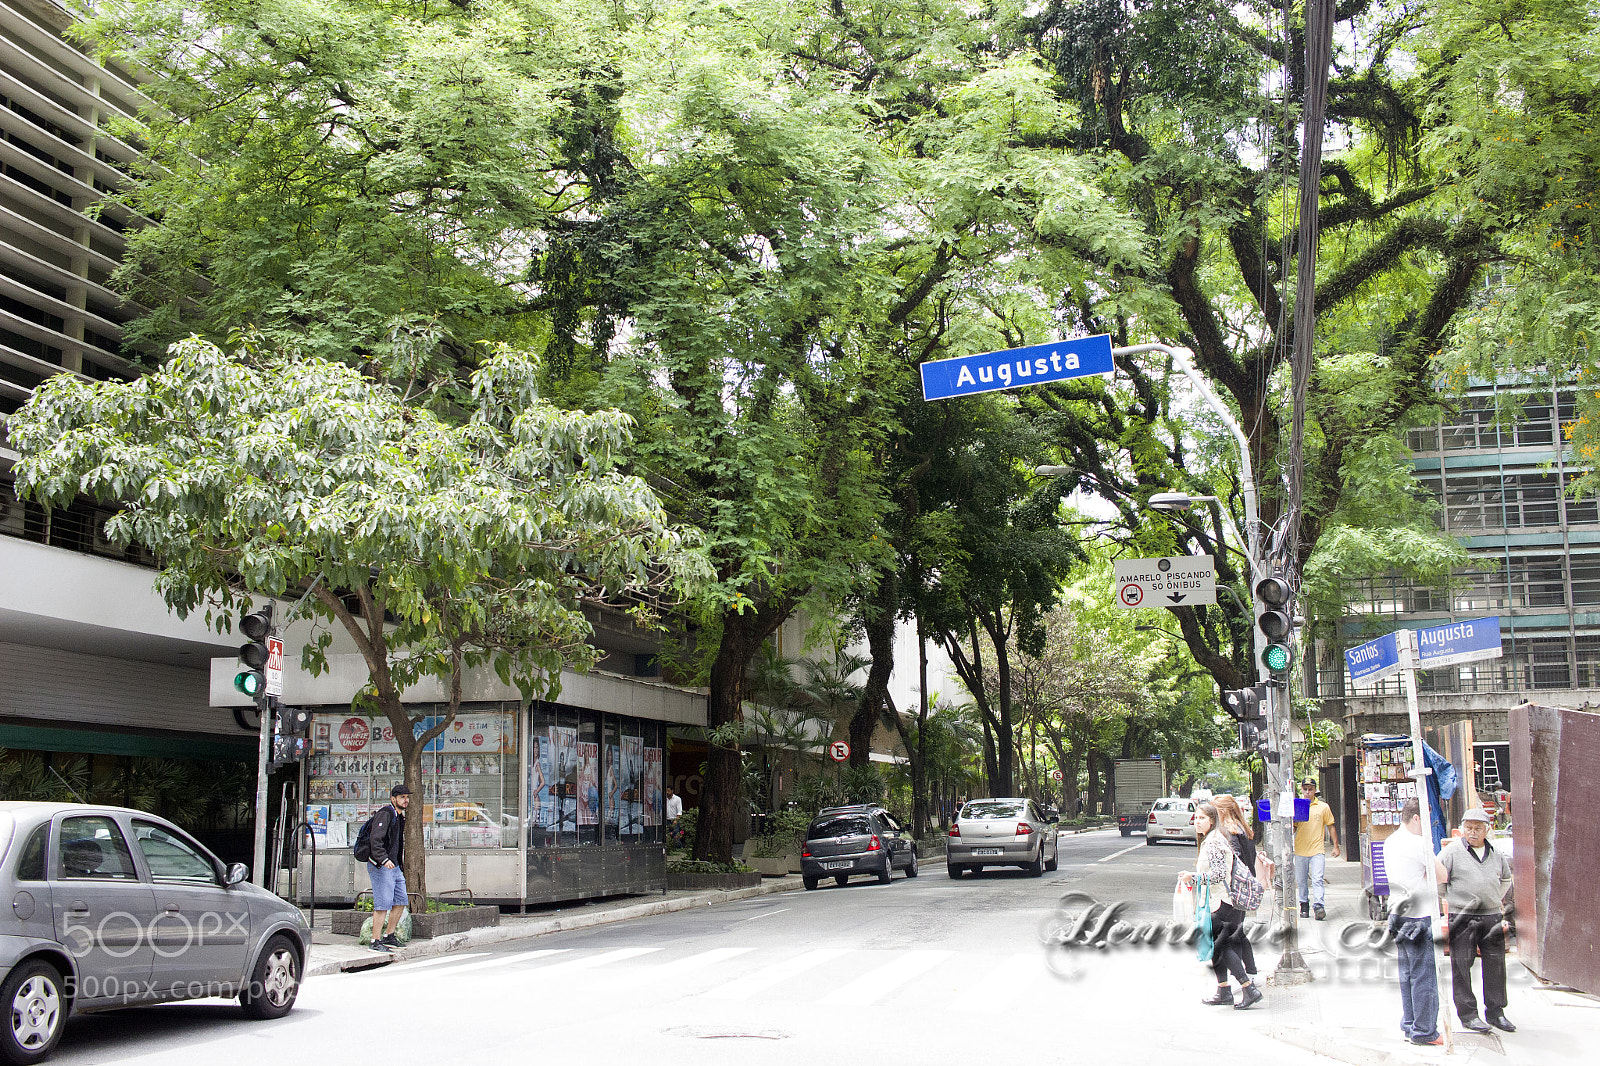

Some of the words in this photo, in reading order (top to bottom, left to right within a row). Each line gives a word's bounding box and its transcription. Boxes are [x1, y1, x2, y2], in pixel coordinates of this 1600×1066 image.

[956, 351, 1080, 387] Augusta
[1120, 573, 1161, 583] AMARELO
[1166, 570, 1211, 580] PISCANDO
[1166, 580, 1201, 590] ÔNIBUS
[1420, 623, 1474, 646] Augusta
[1349, 644, 1379, 665] Santos
[340, 732, 369, 740] BILHETE
[449, 736, 466, 744] vivo
